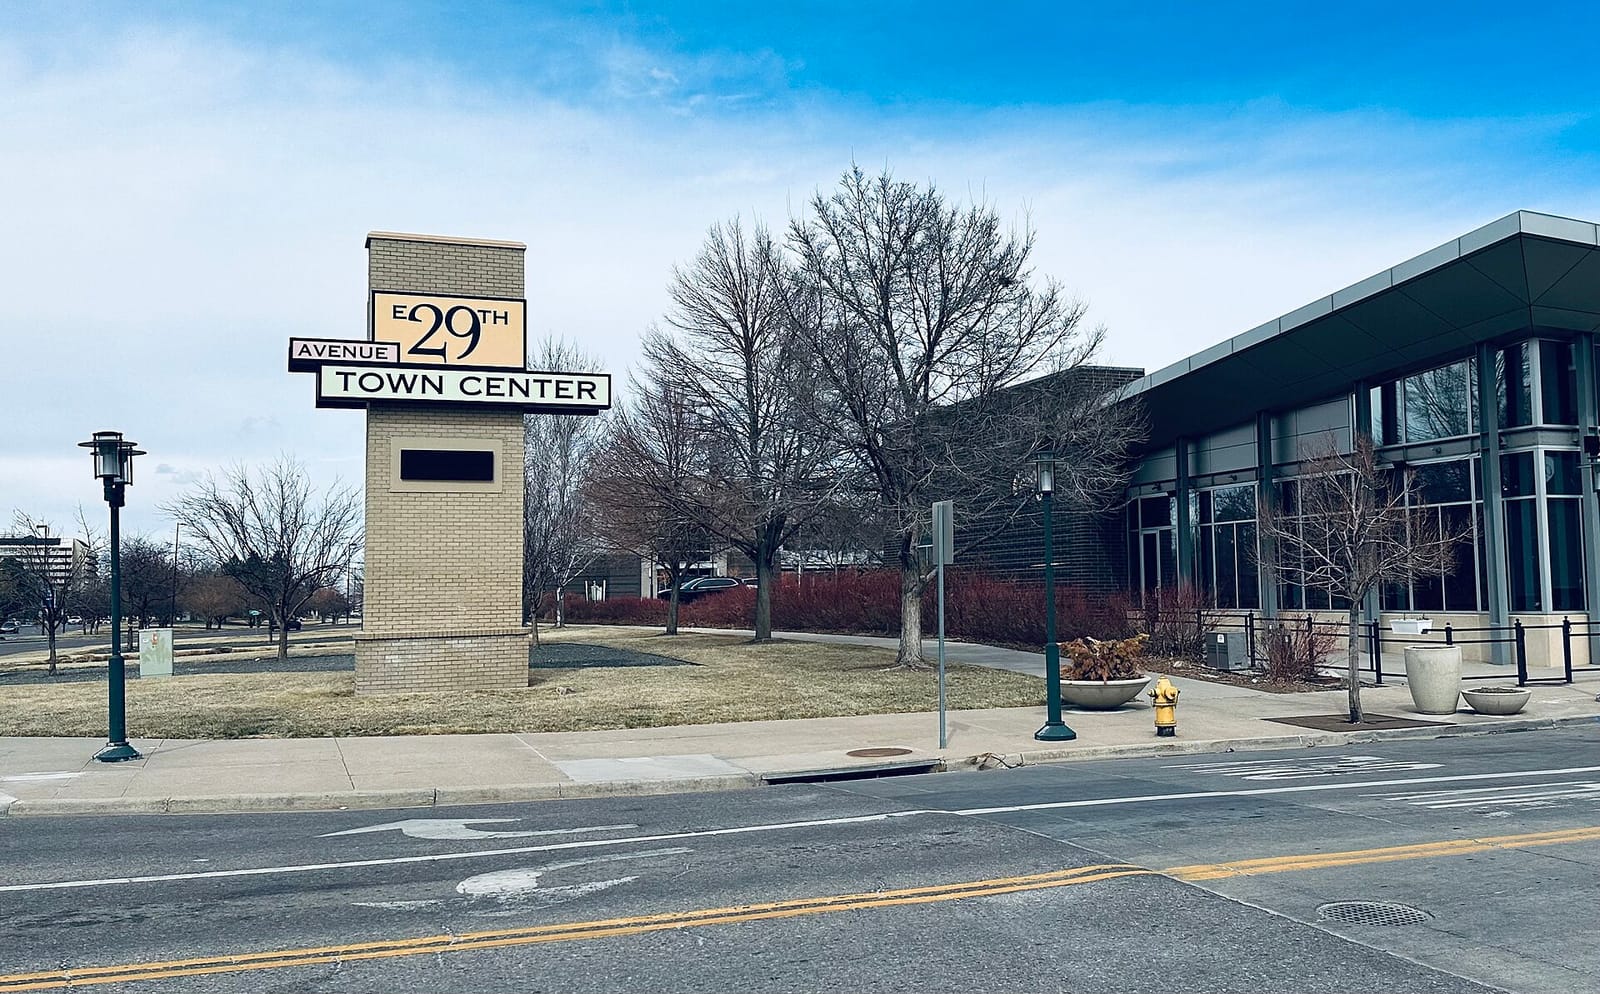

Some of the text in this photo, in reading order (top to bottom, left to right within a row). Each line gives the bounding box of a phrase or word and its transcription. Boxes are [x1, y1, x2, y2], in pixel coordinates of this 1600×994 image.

[298, 343, 388, 360] AVENUE
[335, 371, 597, 400] TOWN CENTER
